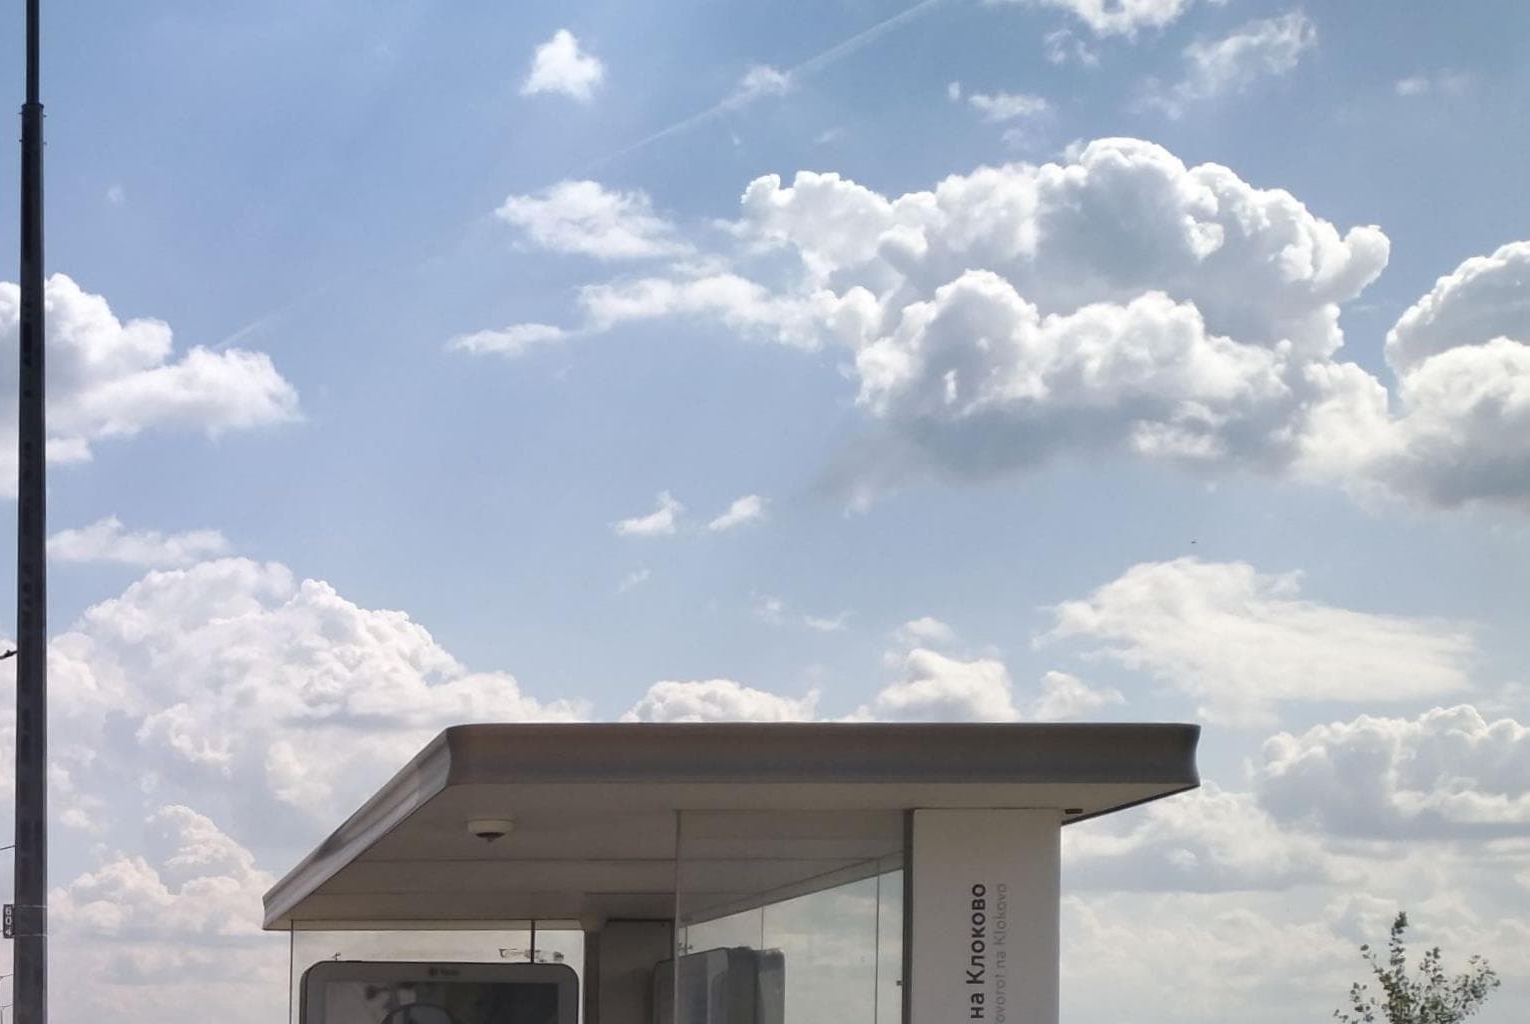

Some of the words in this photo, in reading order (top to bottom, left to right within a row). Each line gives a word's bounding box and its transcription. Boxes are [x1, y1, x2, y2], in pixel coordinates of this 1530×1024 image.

[965, 883, 986, 985] Клоково
[992, 883, 1008, 946] Klokovo
[996, 951, 1007, 969] na
[970, 992, 985, 1019] на
